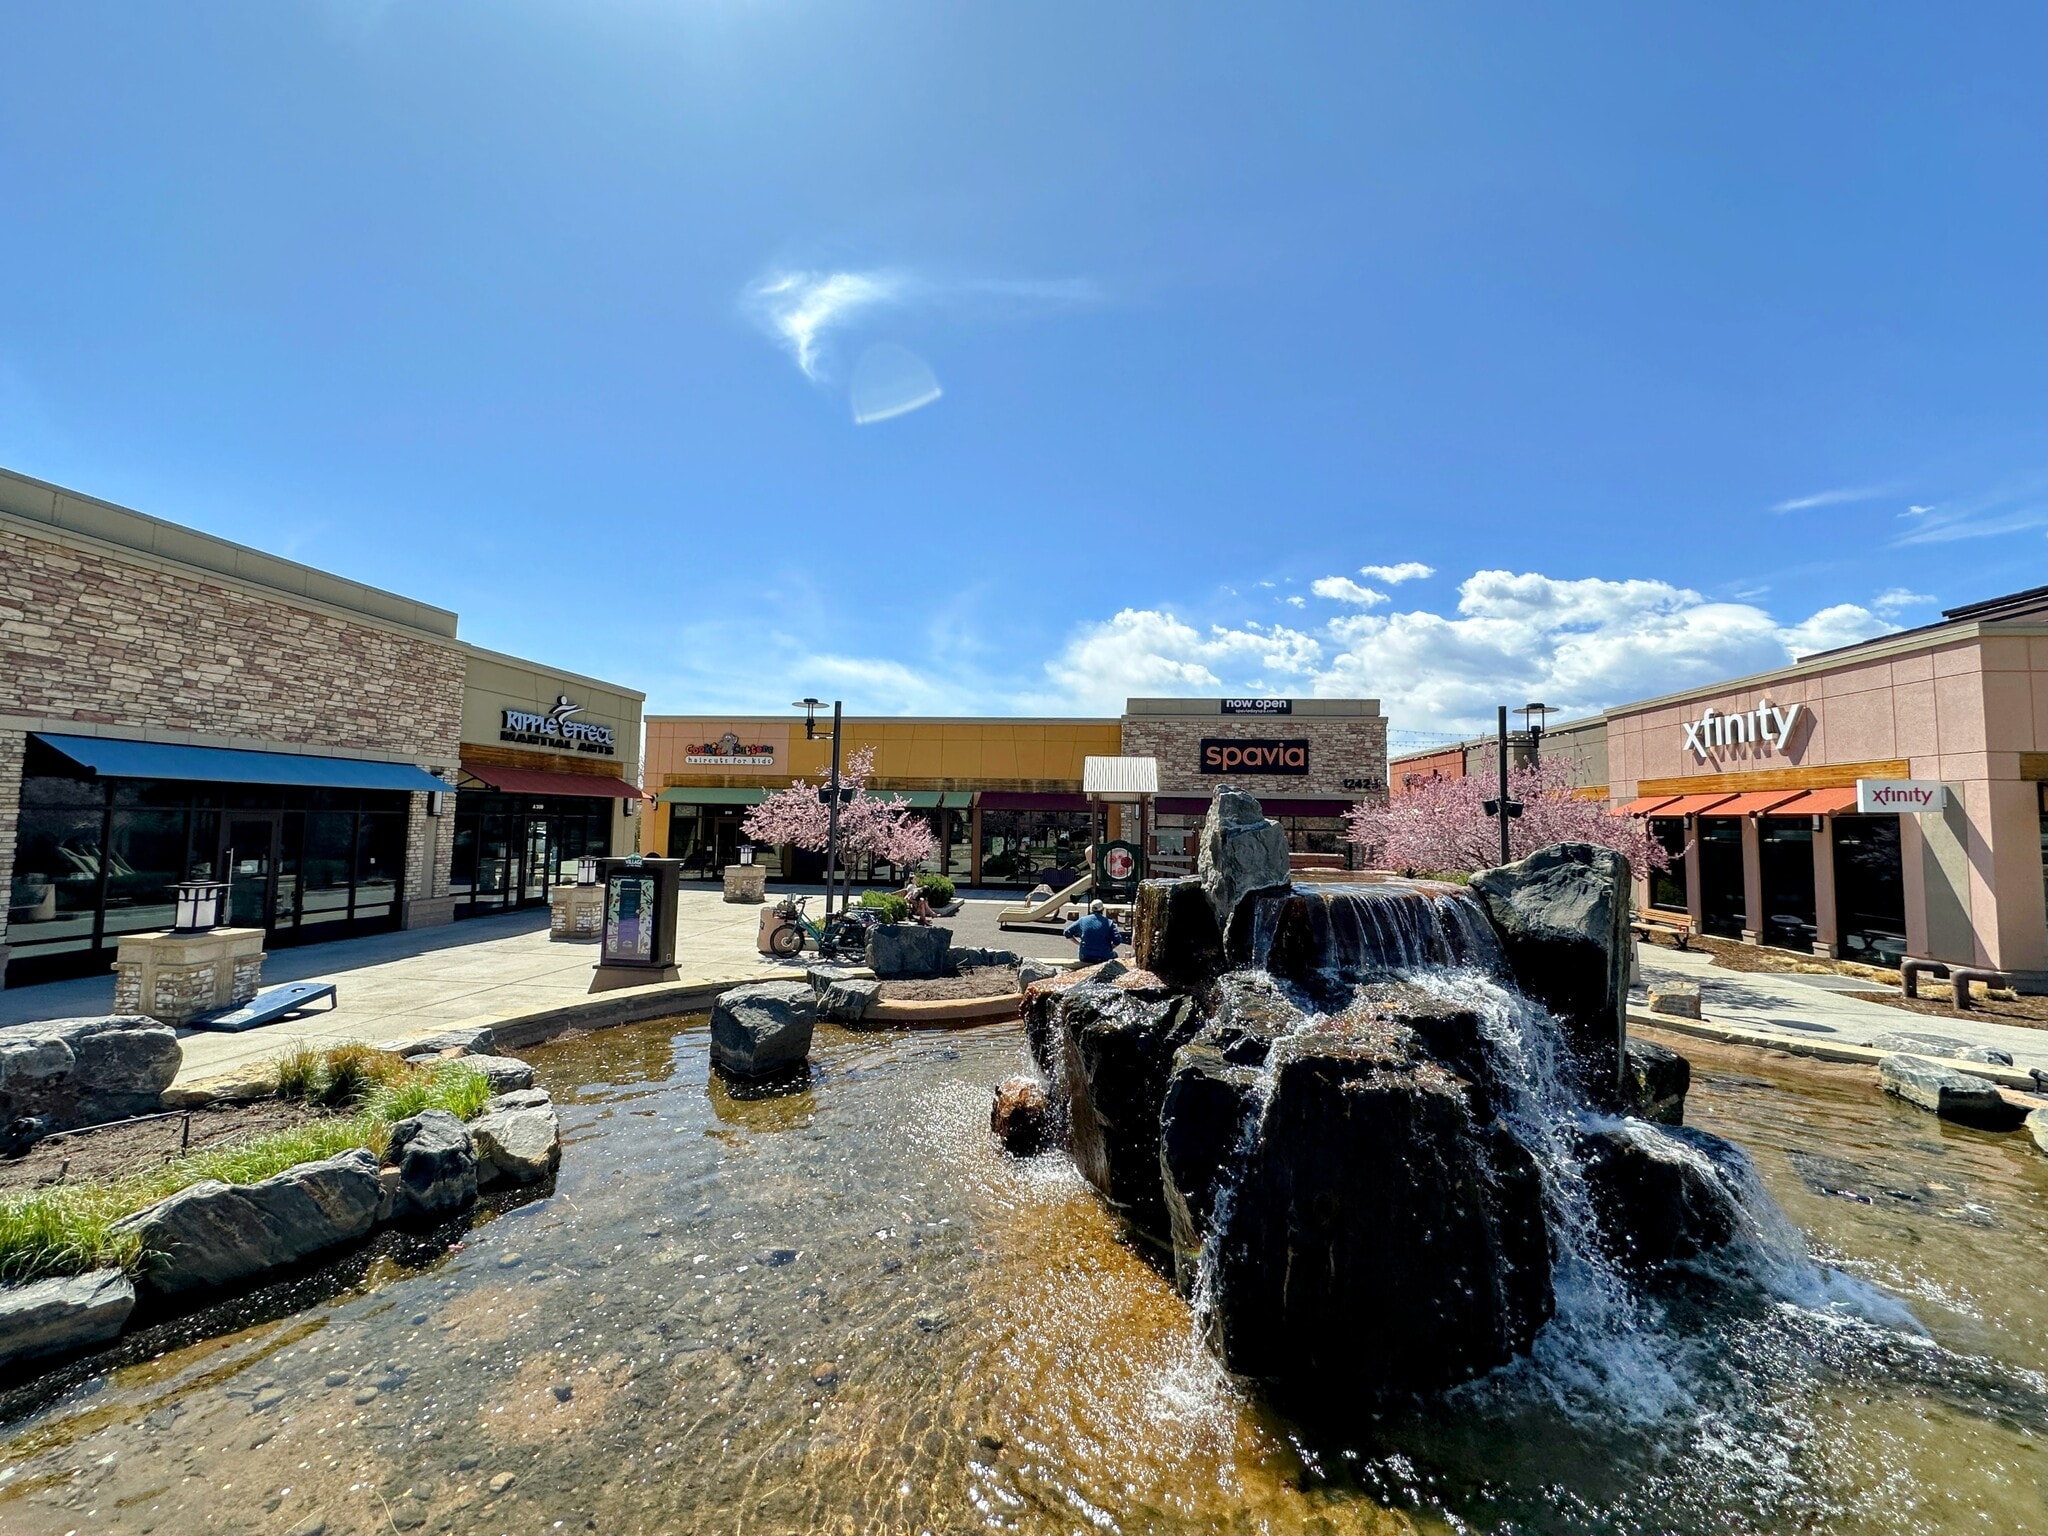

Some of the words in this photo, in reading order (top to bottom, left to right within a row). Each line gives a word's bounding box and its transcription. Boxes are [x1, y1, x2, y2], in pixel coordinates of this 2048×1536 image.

[1226, 699, 1253, 708] now
[1255, 699, 1287, 710] open
[502, 709, 560, 735] RIPPLE
[560, 720, 615, 745] EFFECT
[1682, 698, 1802, 758] xfinity
[500, 730, 575, 750] MARTIAL
[577, 742, 615, 755] ARTS
[1206, 742, 1305, 771] spavia
[1872, 786, 1934, 806] xfinity
